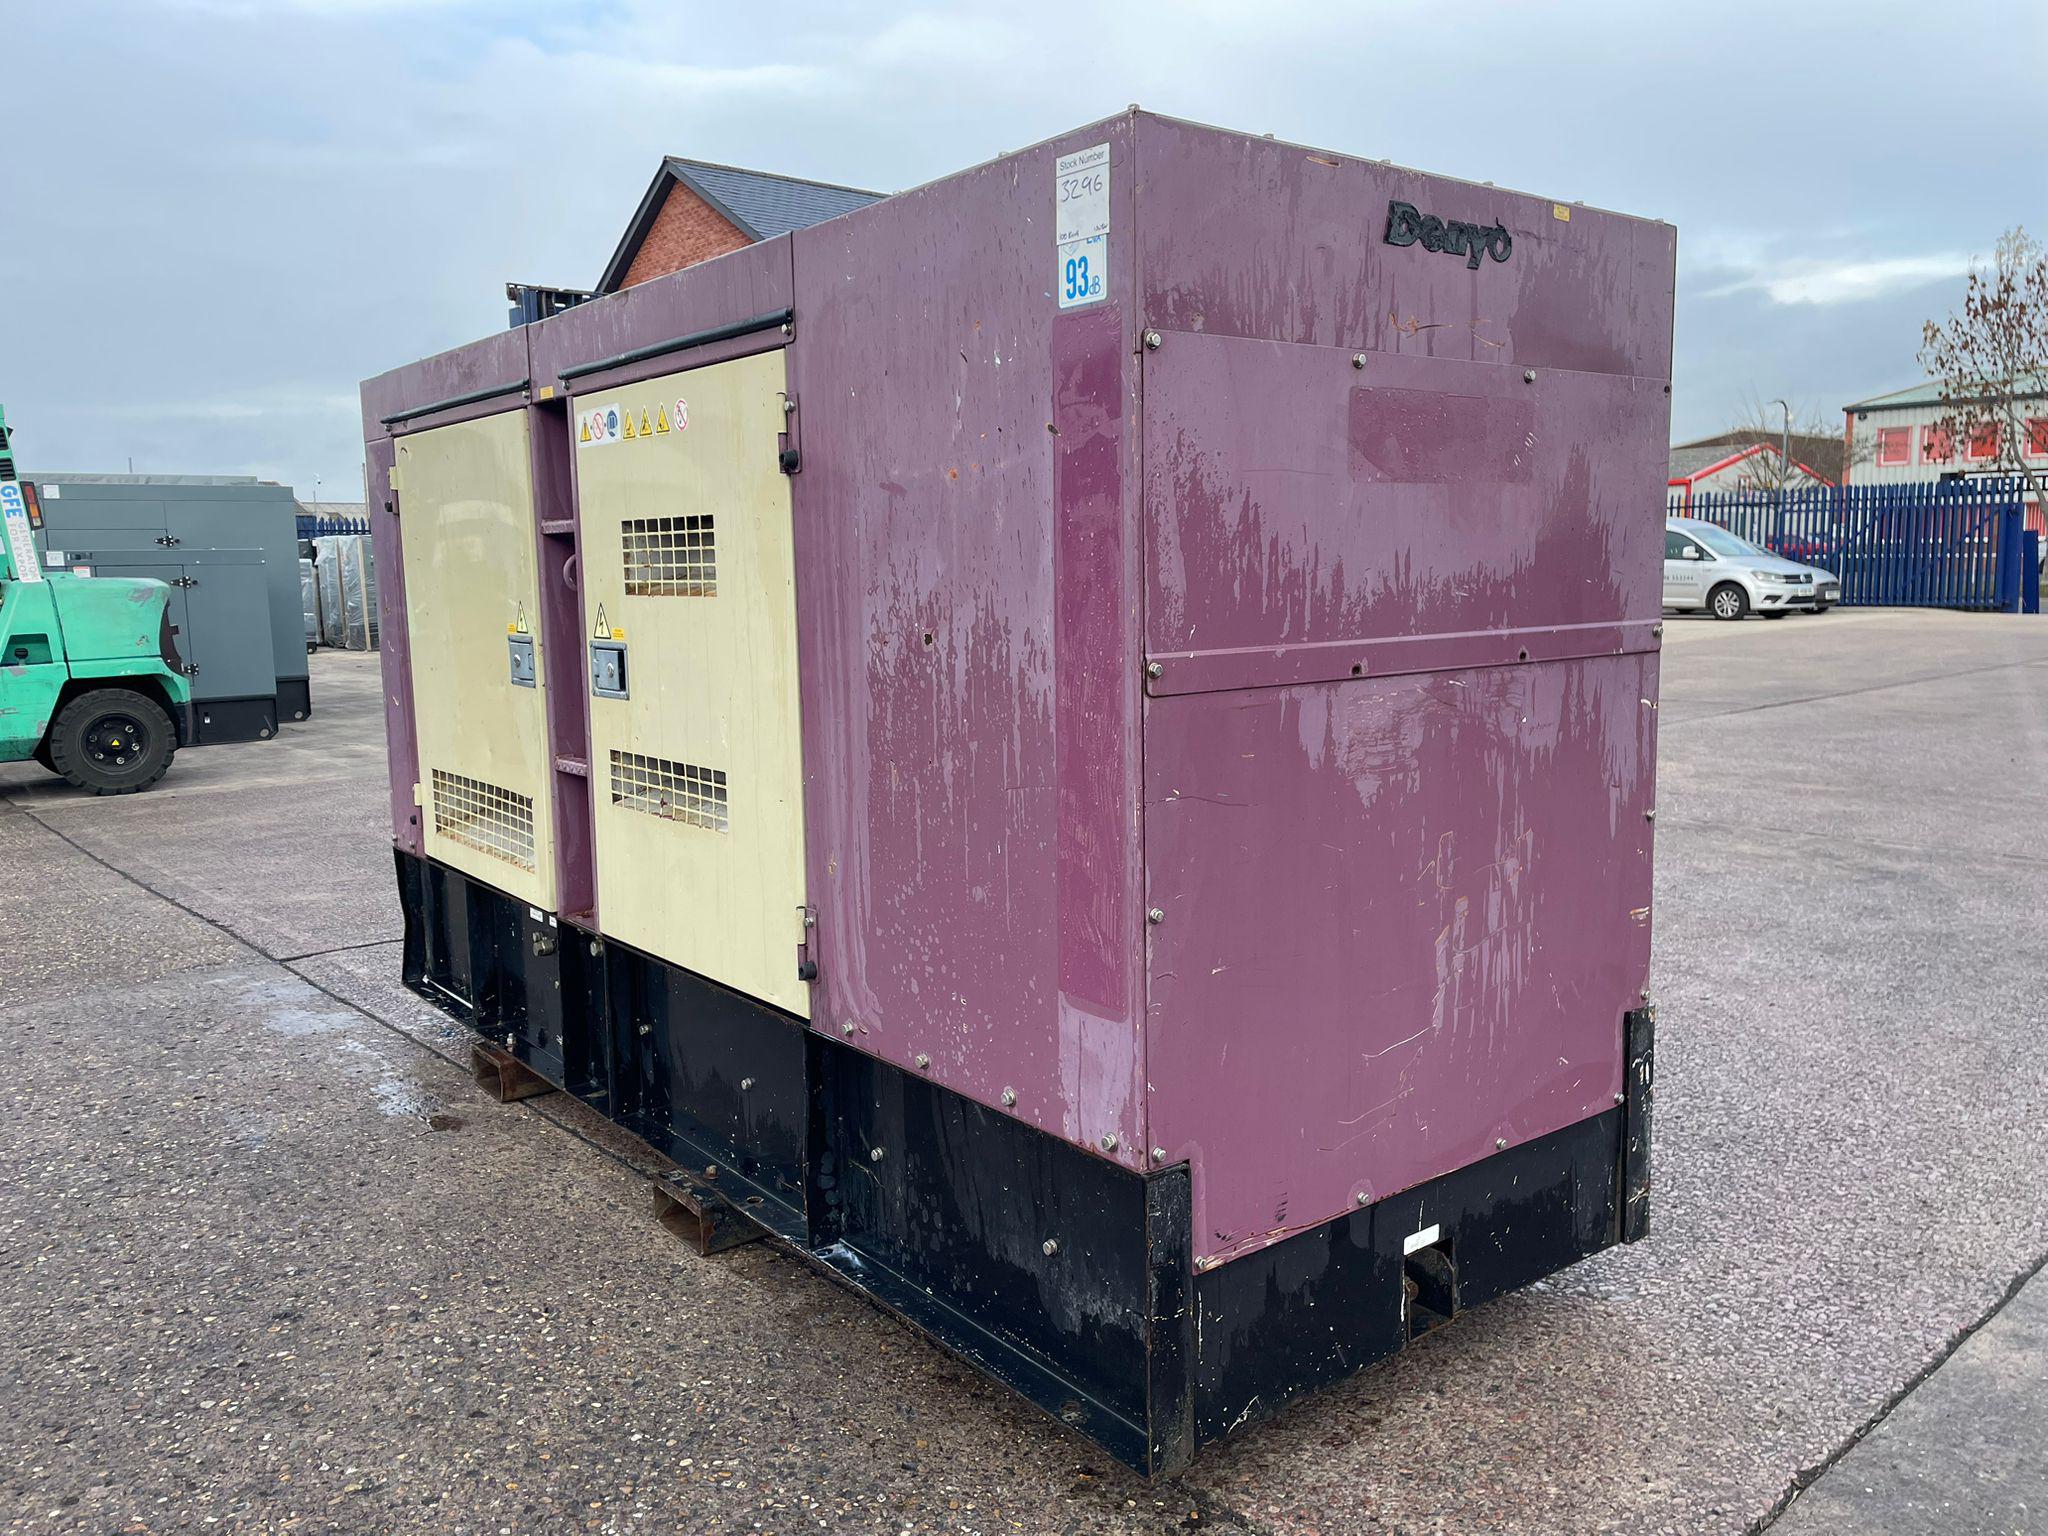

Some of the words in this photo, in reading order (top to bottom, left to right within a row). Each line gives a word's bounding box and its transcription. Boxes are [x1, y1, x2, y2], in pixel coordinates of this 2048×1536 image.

[1060, 158, 1078, 171] Stock
[1079, 151, 1104, 165] Number
[1061, 174, 1103, 202] 3296
[1066, 256, 1089, 299] 93
[1089, 275, 1101, 295] dB
[0, 485, 23, 518] GFE
